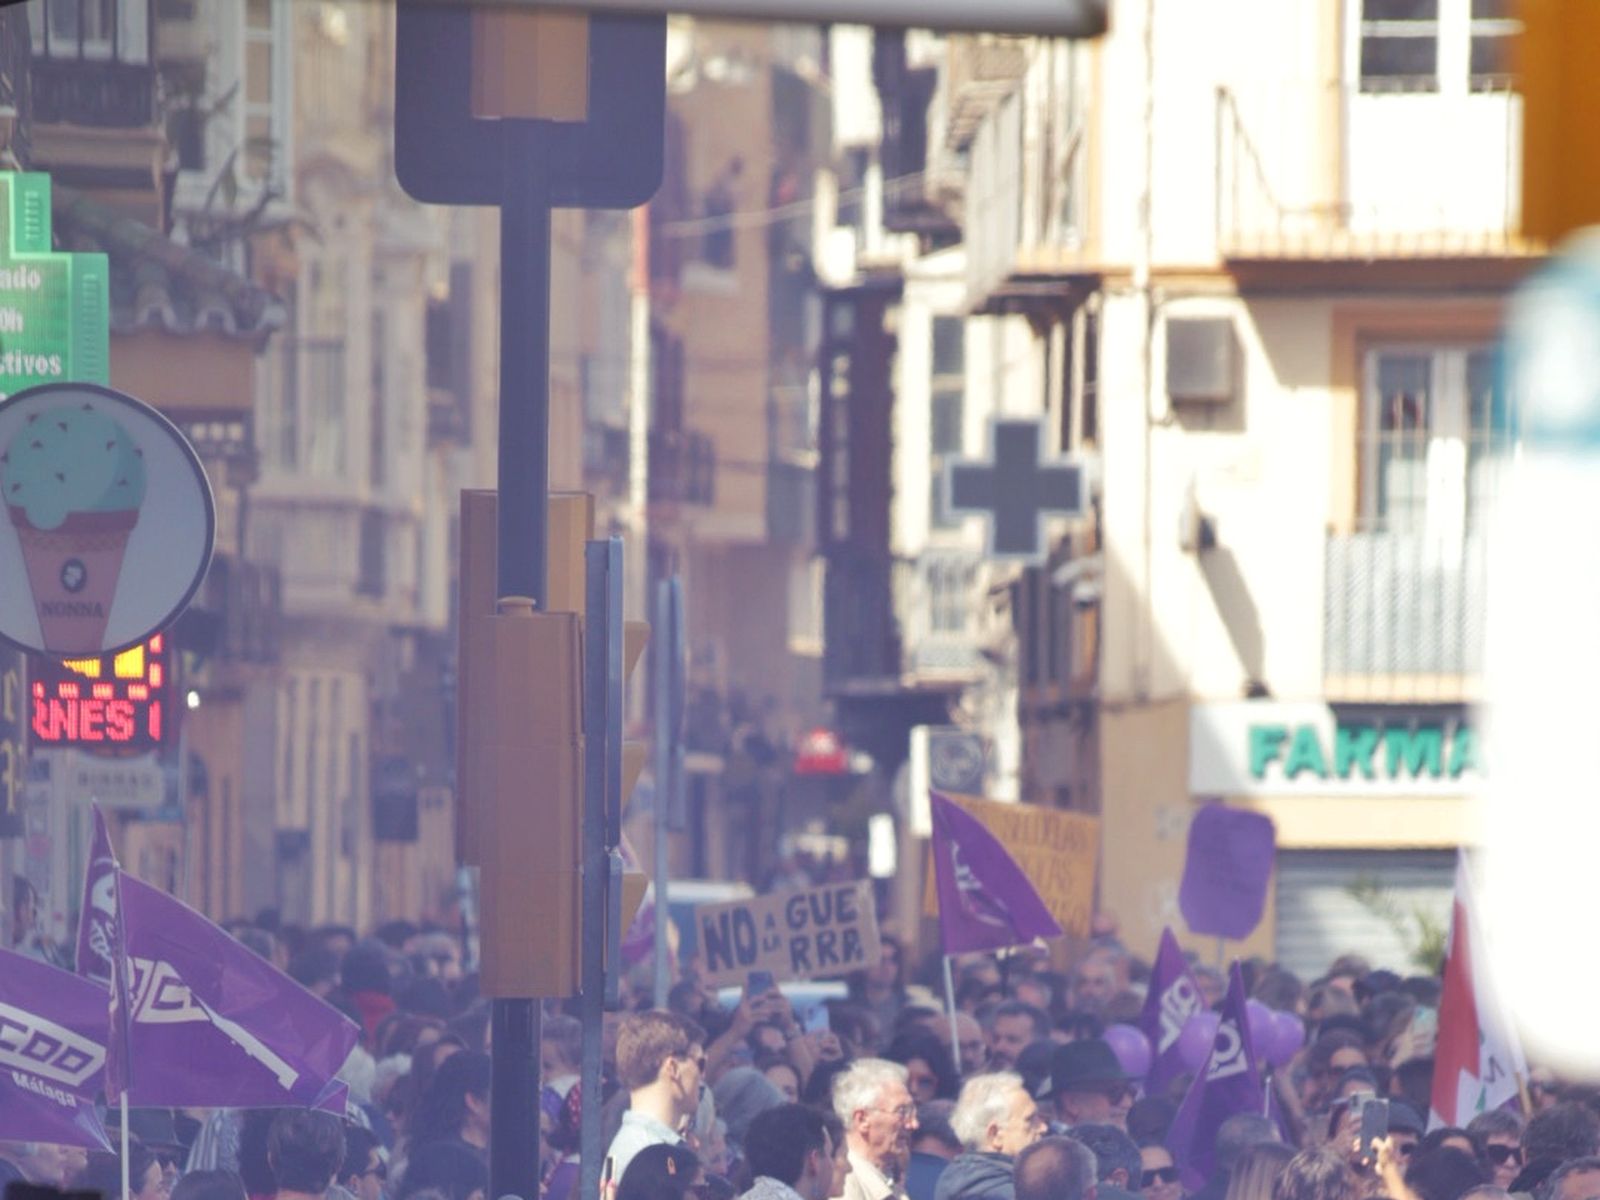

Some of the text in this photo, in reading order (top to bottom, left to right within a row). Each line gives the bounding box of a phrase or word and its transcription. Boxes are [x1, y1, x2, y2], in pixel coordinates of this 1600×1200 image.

[41, 601, 105, 618] NONNA
[785, 885, 859, 931] GUE
[702, 906, 758, 972] NO
[12, 1069, 78, 1108] Málaga
